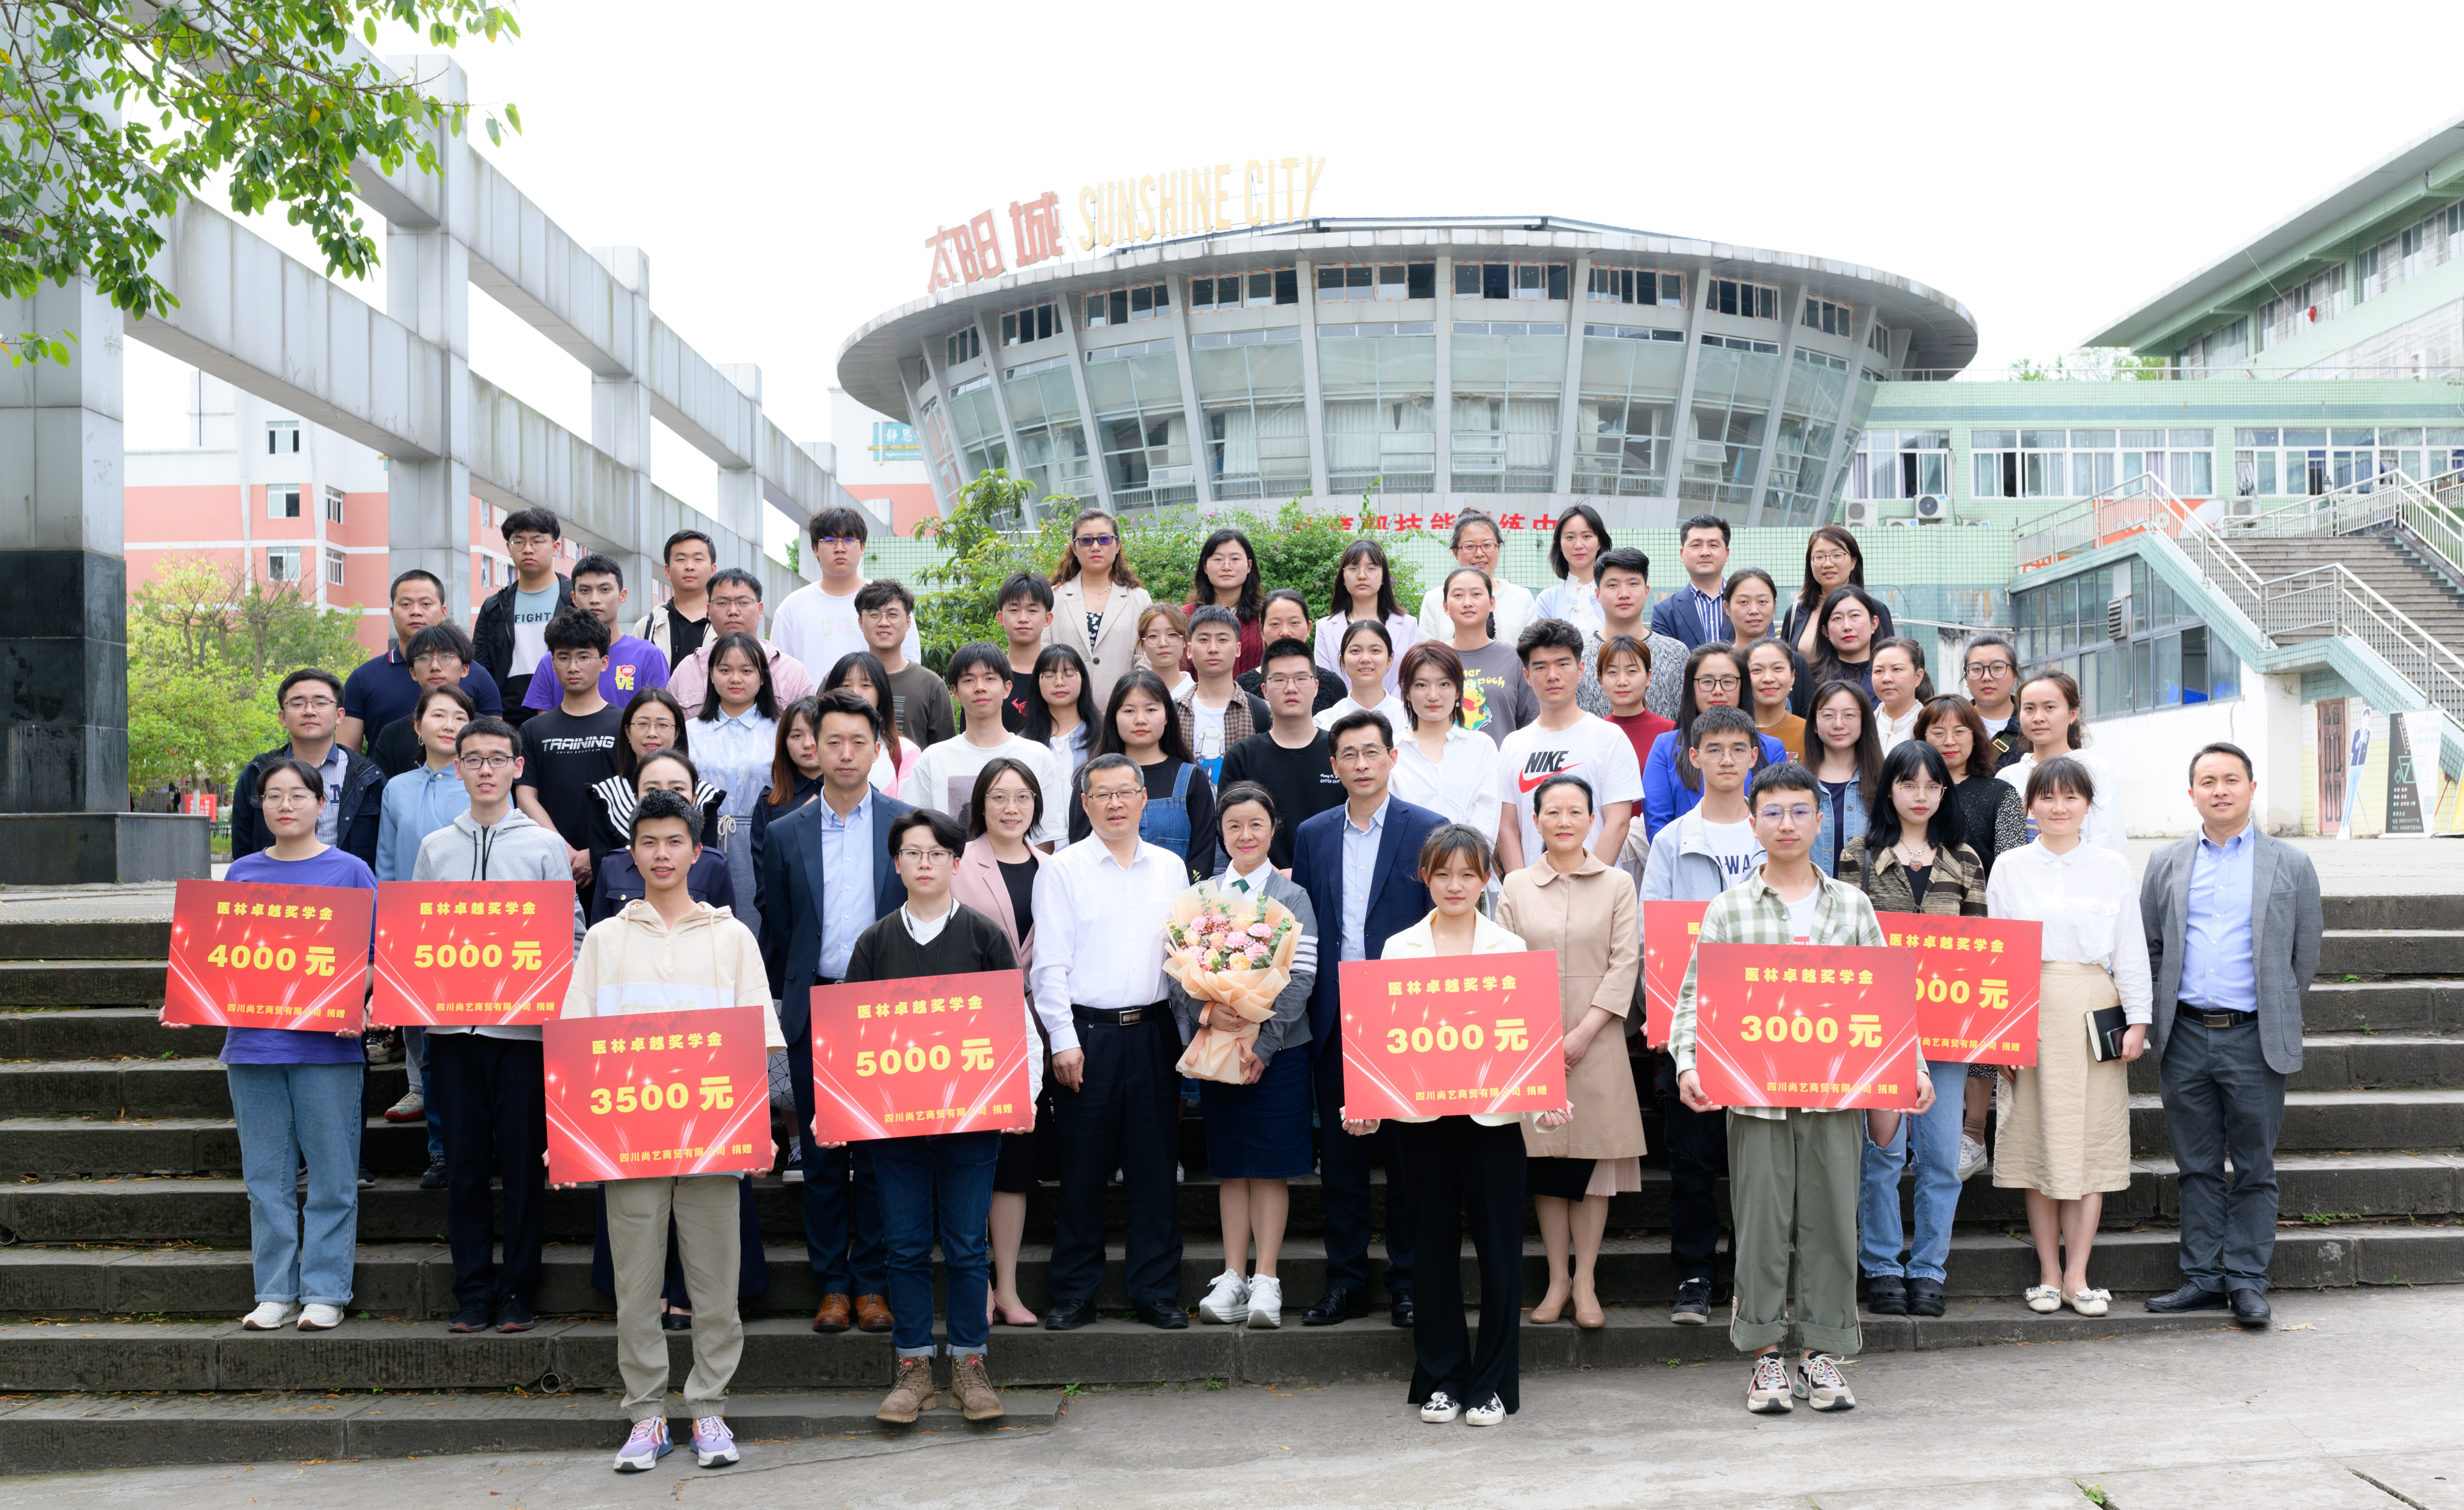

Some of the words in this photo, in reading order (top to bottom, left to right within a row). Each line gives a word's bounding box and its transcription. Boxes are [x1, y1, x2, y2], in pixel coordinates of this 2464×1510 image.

[1079, 164, 1231, 251] SUNSHINE
[1245, 155, 1326, 227] CITY
[885, 428, 916, 442] 静思
[515, 612, 551, 623] FIGHT
[542, 736, 615, 752] TRAINING
[1524, 751, 1570, 773] NIKE
[217, 902, 332, 920] 医林卓越奖学金
[420, 901, 535, 916] 医林卓越奖学金
[1890, 934, 2004, 953] 医林卓越奖学金
[208, 945, 296, 971] 4000
[305, 946, 335, 976] 元
[414, 944, 502, 967] 5000
[512, 941, 542, 970] 元
[1388, 975, 1516, 995] 医林卓越奖学金
[1745, 967, 1873, 984] 医林卓越奖学金
[1979, 979, 2008, 1009] 元
[228, 1004, 321, 1017] 四川尚艺商贸有限公司
[327, 1009, 345, 1018] 捐赠
[437, 1002, 531, 1011] 四川尚艺商贸有限公司
[537, 1002, 554, 1011] 捐赠
[858, 995, 982, 1018] 医林卓越奖学金
[1387, 1024, 1484, 1054] 3000
[1494, 1018, 1528, 1052] 元
[1740, 1015, 1838, 1043] 3000
[1849, 1015, 1882, 1047] 元
[592, 1032, 722, 1054] 医林卓越奖学金
[2002, 1042, 2020, 1052] 捐赠
[856, 1045, 951, 1076] 5000
[961, 1038, 994, 1072] 元
[590, 1083, 689, 1114] 3500
[699, 1076, 734, 1110] 元
[1416, 1086, 1521, 1101] 四川尚艺商贸有限公司
[1527, 1085, 1547, 1095] 捐赠
[1767, 1082, 1872, 1093] 四川尚艺商贸有限公司
[1878, 1084, 1898, 1094] 捐赠
[885, 1106, 987, 1123] 四川尚艺商贸有限公司
[993, 1103, 1012, 1114] 捐赠
[620, 1146, 725, 1162] 四川尚艺商贸有限公司
[732, 1144, 752, 1154] 捐赠
